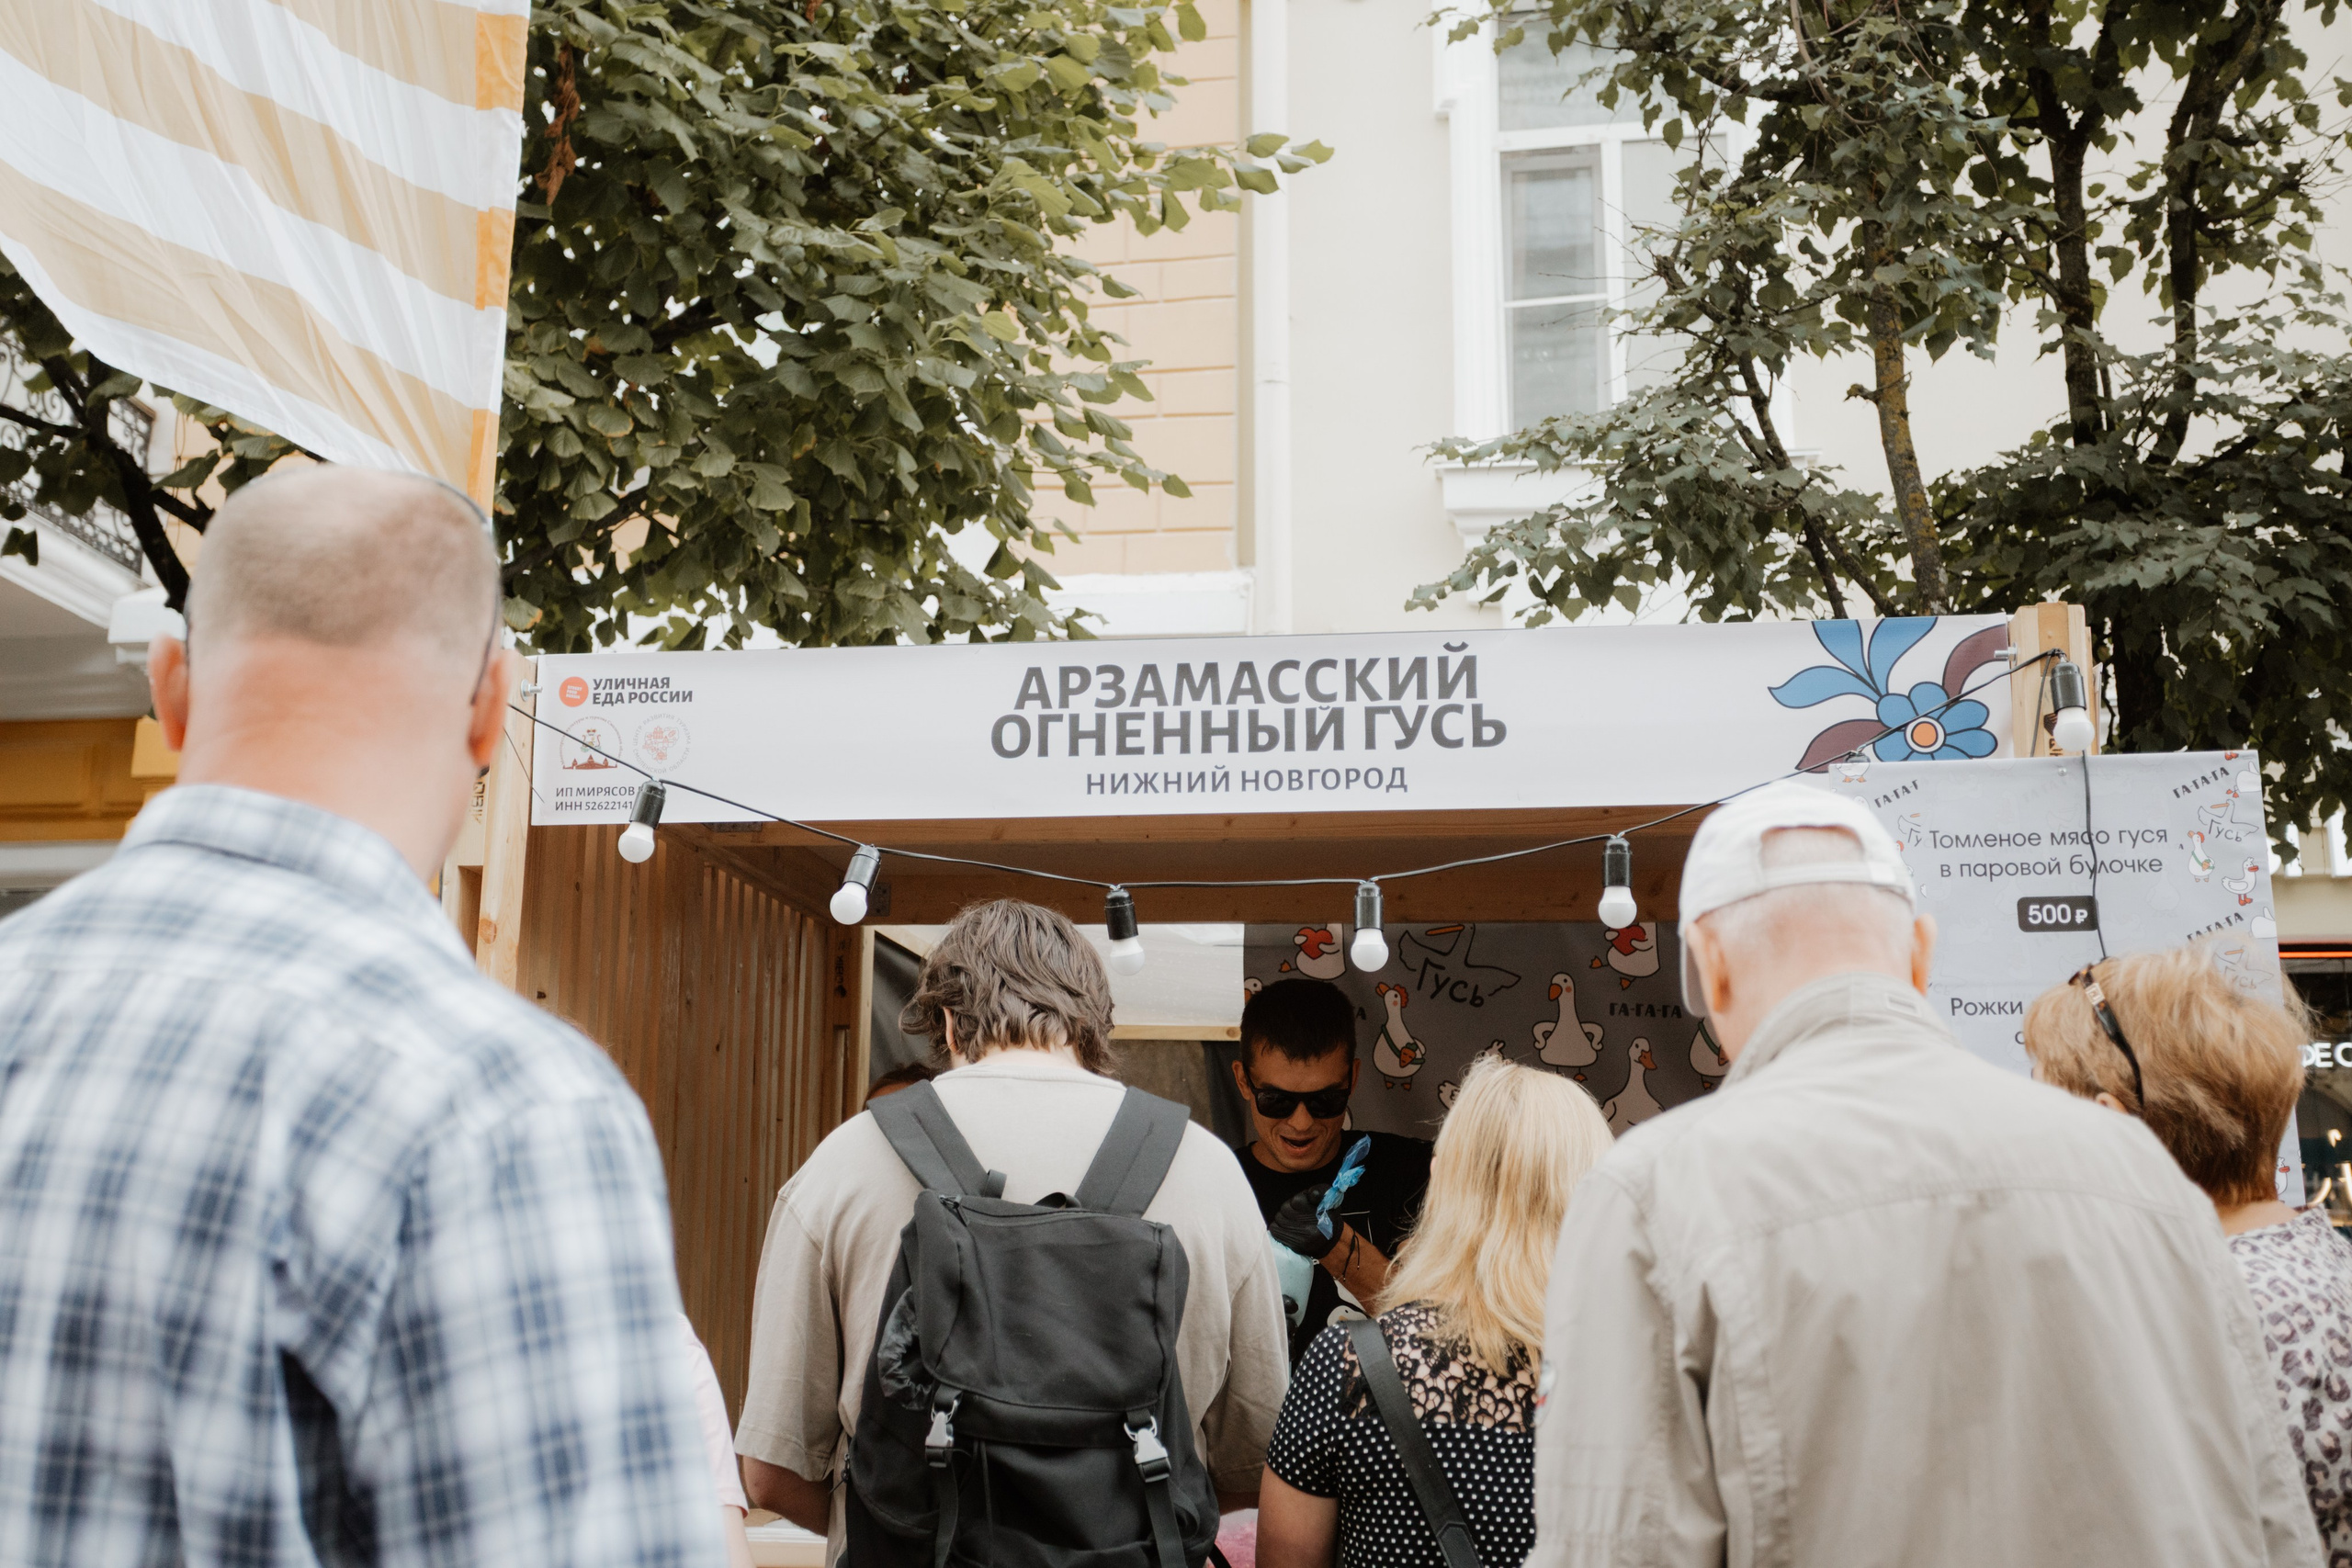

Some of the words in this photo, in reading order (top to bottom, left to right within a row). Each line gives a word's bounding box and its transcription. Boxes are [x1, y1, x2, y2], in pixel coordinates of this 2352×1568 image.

[593, 677, 670, 690] УЛИЧНАЯ
[1013, 641, 1477, 710] АРЗАМАССКИЙ
[593, 693, 625, 706] ЕДА
[628, 691, 693, 704] РОССИИ
[990, 705, 1344, 759] ОГНЕННЫЙ
[1364, 703, 1508, 750] ГУСЬ
[1086, 764, 1230, 795] НИЖНИЙ
[1240, 766, 1408, 793] НОВГОРОД
[2173, 766, 2230, 798] ГА-ГА-ГА
[556, 787, 572, 797] ИП
[575, 786, 635, 796] МИРЯСОВ
[555, 801, 582, 811] ИНН
[584, 801, 633, 810] 52622141
[1929, 829, 2041, 849] Томленое
[2051, 829, 2109, 847] мясо
[2119, 829, 2168, 848] гуся
[1940, 863, 1951, 877] в
[1960, 857, 2062, 882] паровой
[2070, 854, 2163, 879] булочке
[1610, 1002, 1682, 1019] ГА-ГА-ГА
[1951, 998, 2023, 1016] Рожки
